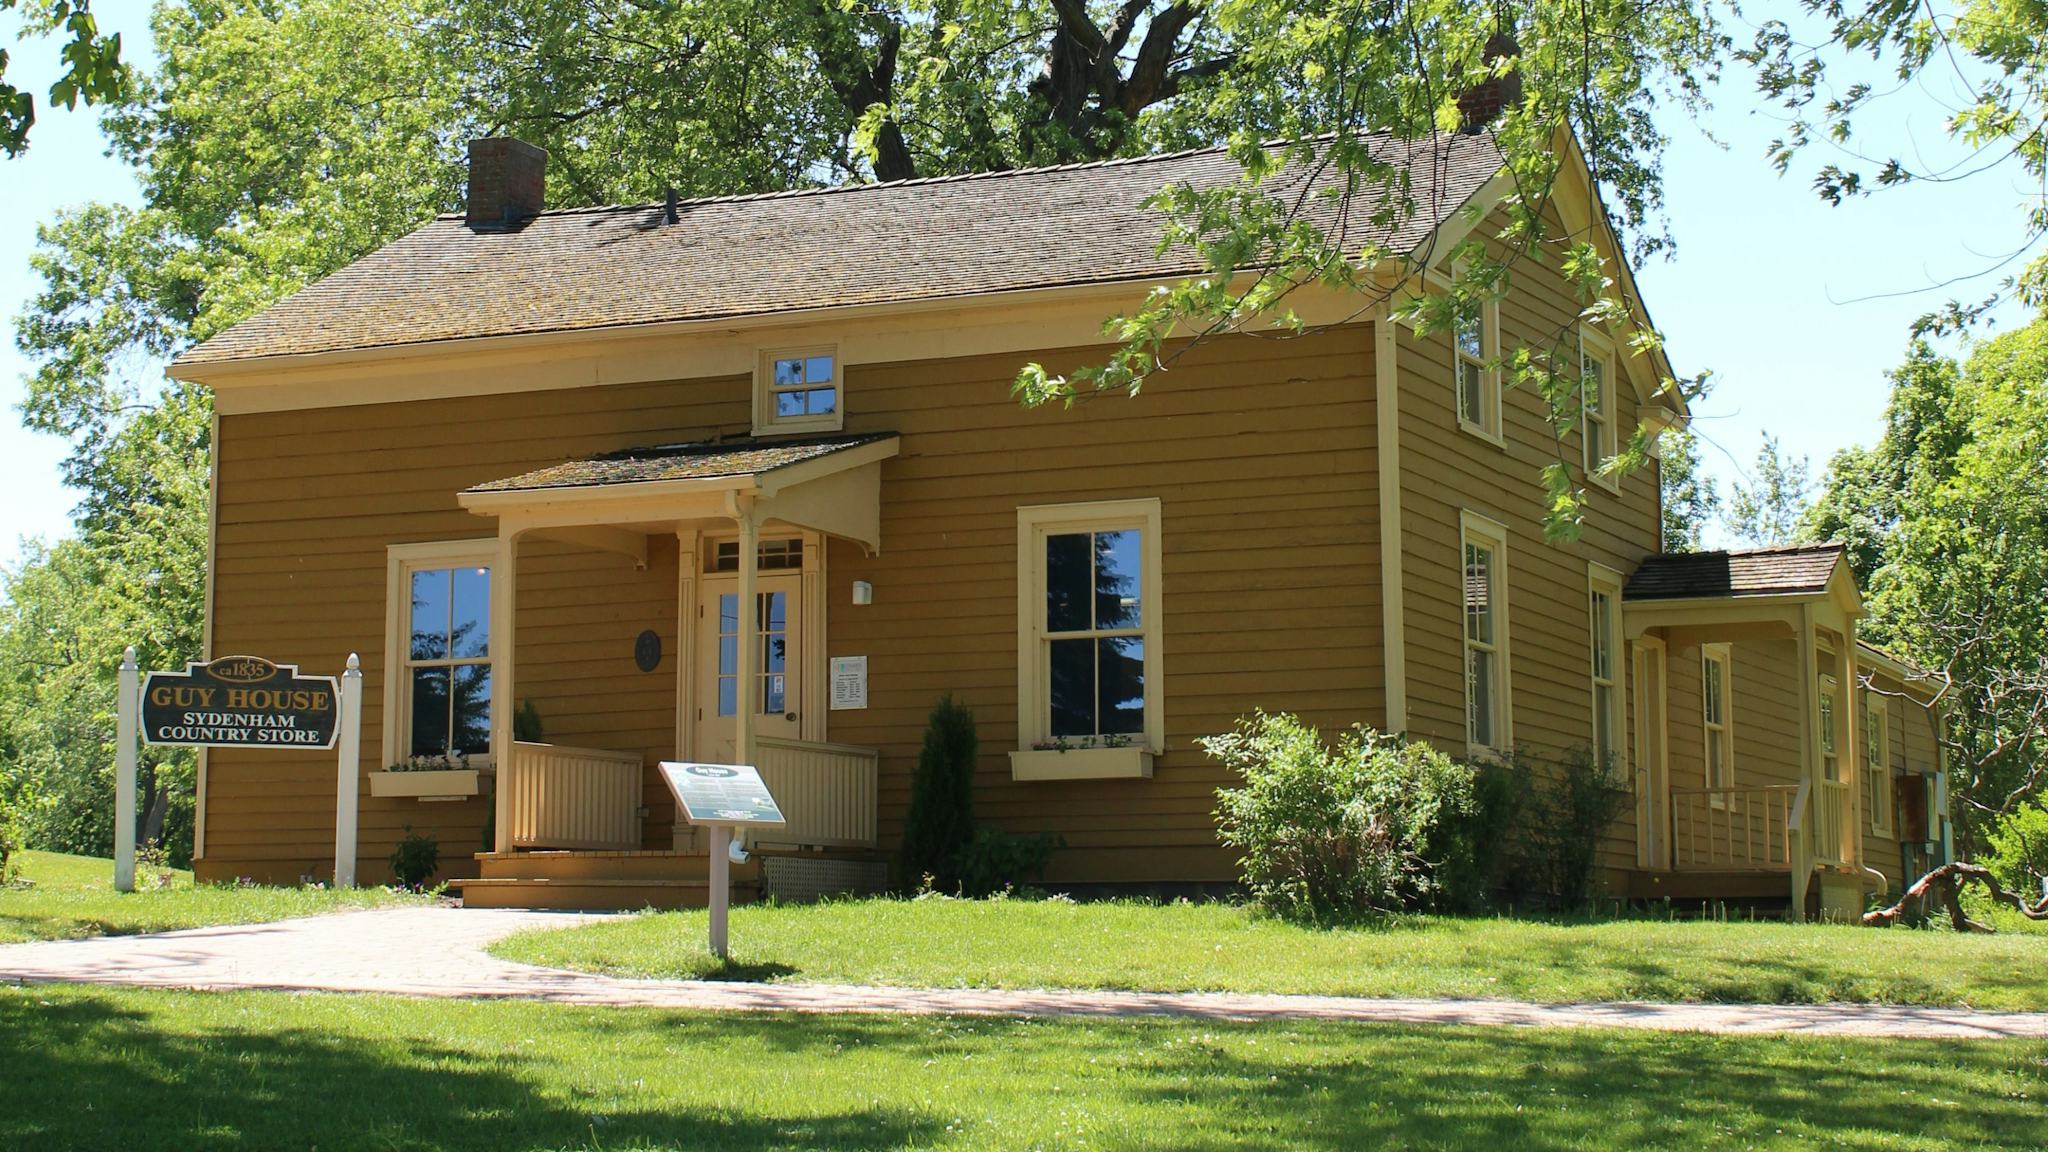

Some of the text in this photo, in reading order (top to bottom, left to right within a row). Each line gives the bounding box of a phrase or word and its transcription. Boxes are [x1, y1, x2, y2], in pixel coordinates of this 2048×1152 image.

[151, 687, 329, 710] GUY HOUSE
[183, 711, 296, 728] SYDENHAM
[158, 726, 320, 743] COUNTRY STORE
